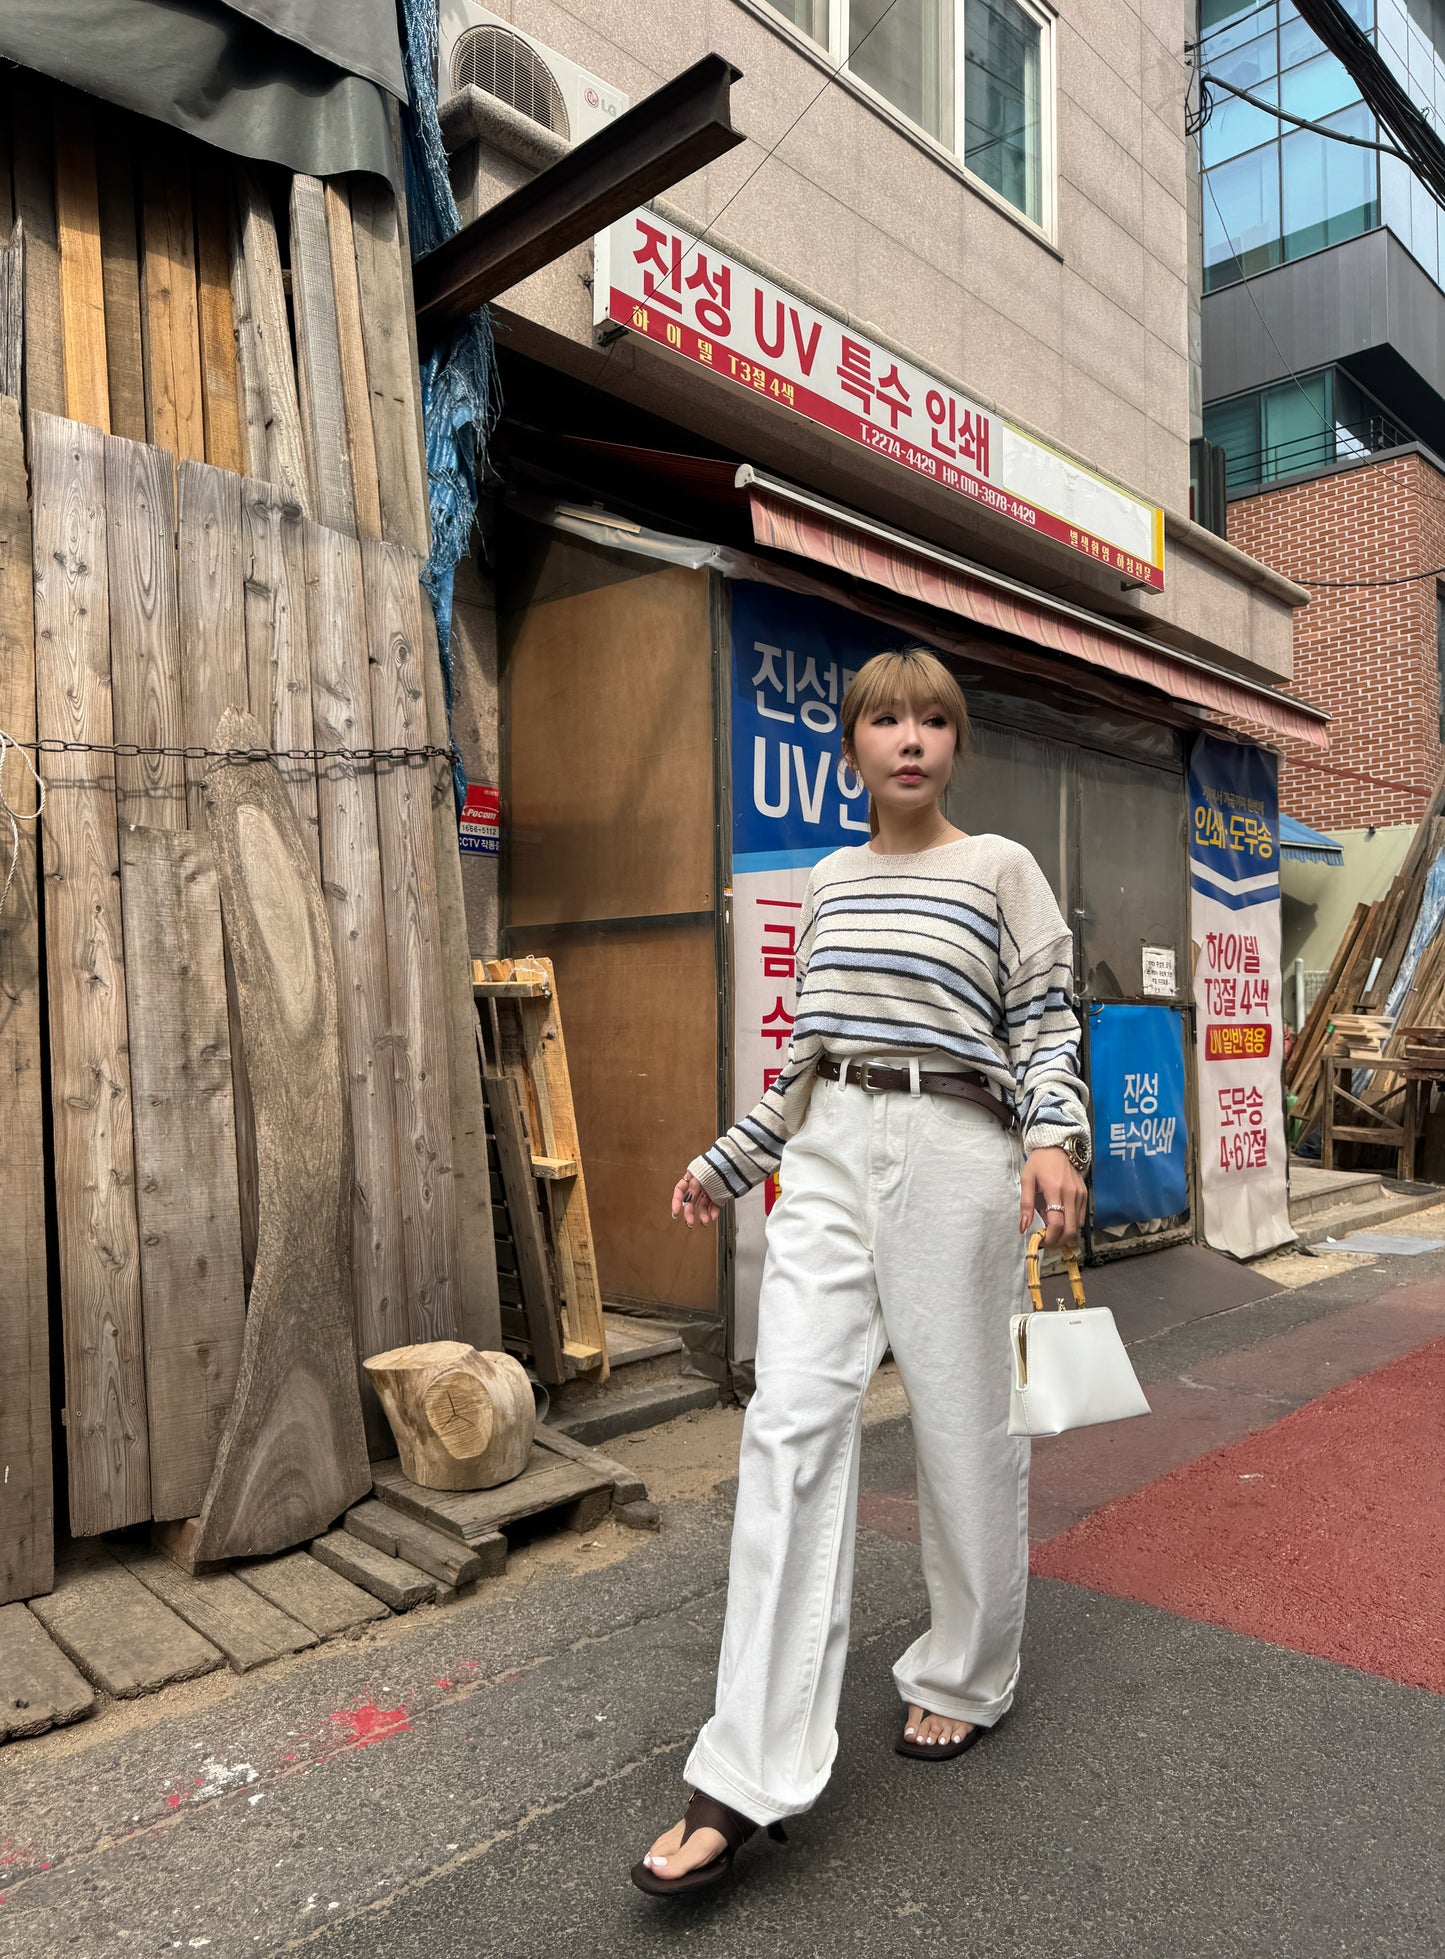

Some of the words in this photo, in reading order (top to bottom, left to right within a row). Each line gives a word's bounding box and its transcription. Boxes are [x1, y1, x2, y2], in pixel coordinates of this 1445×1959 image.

[602, 99, 617, 117] LG
[633, 218, 732, 338] 진성
[754, 288, 822, 377] UV
[837, 334, 912, 429] 특수
[925, 389, 990, 478] 인쇄
[752, 641, 858, 734] 진성
[459, 837, 480, 849] CTV
[462, 824, 497, 836] 1666-5112
[1205, 931, 1260, 974] 하이델
[1123, 1072, 1158, 1115] 진성
[1218, 1085, 1264, 1128] 도무송
[1109, 1117, 1176, 1162] 특수인쇄
